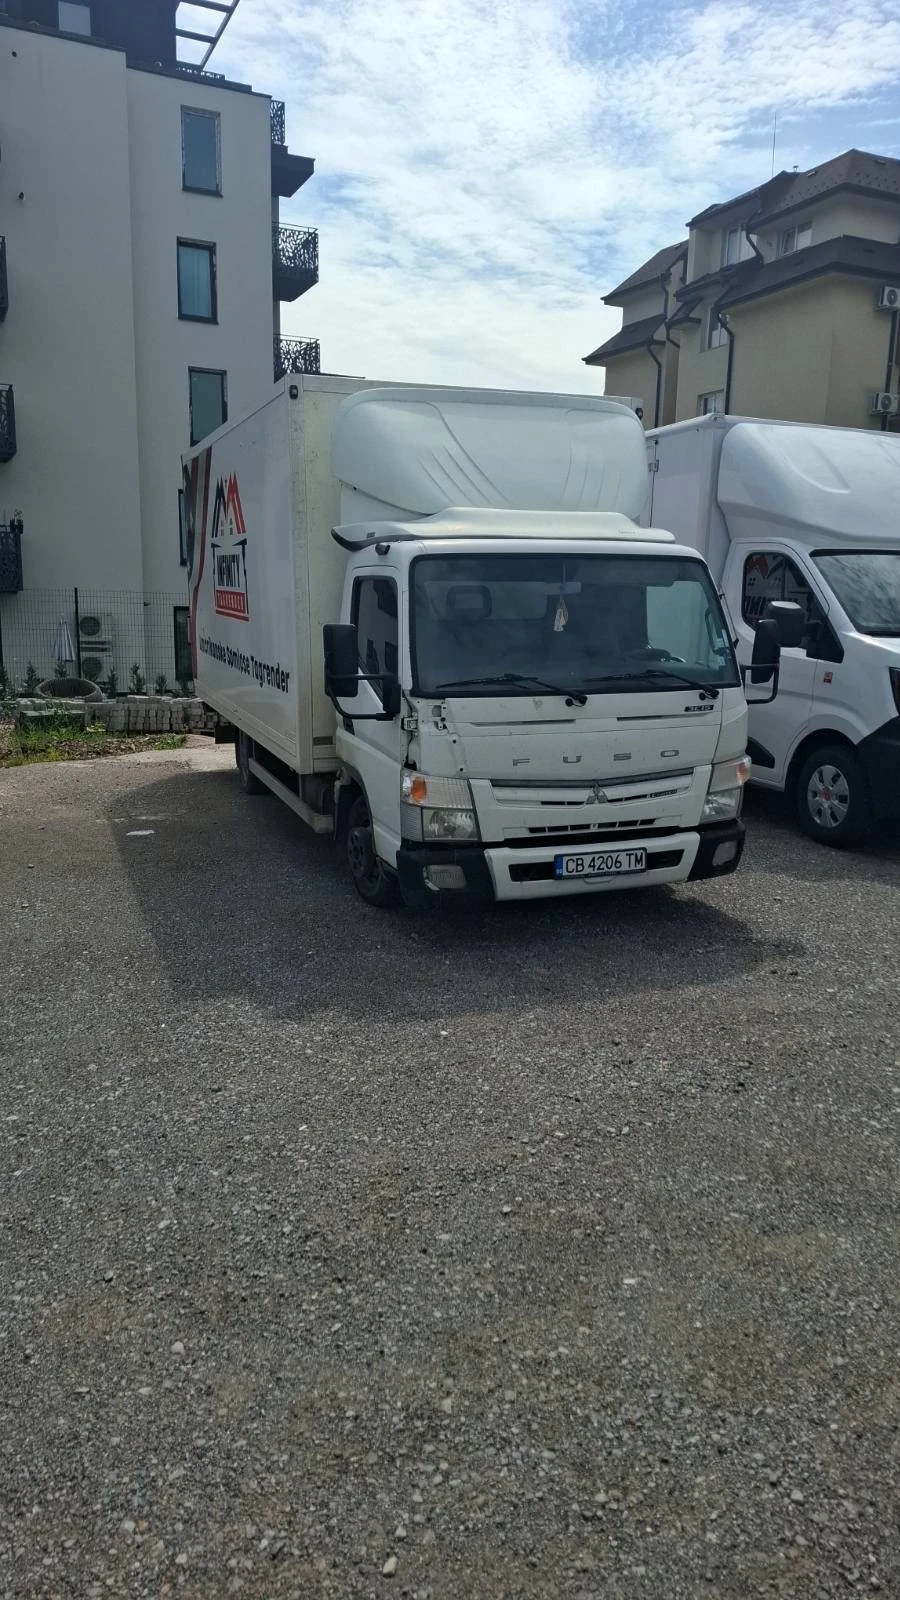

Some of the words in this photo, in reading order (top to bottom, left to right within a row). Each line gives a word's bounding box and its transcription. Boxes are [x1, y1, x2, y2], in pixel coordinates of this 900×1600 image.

[250, 655, 290, 693] Tagrender
[512, 750, 680, 767] FUSO
[565, 857, 585, 874] CB
[588, 854, 622, 872] 4206
[625, 851, 644, 868] TM
